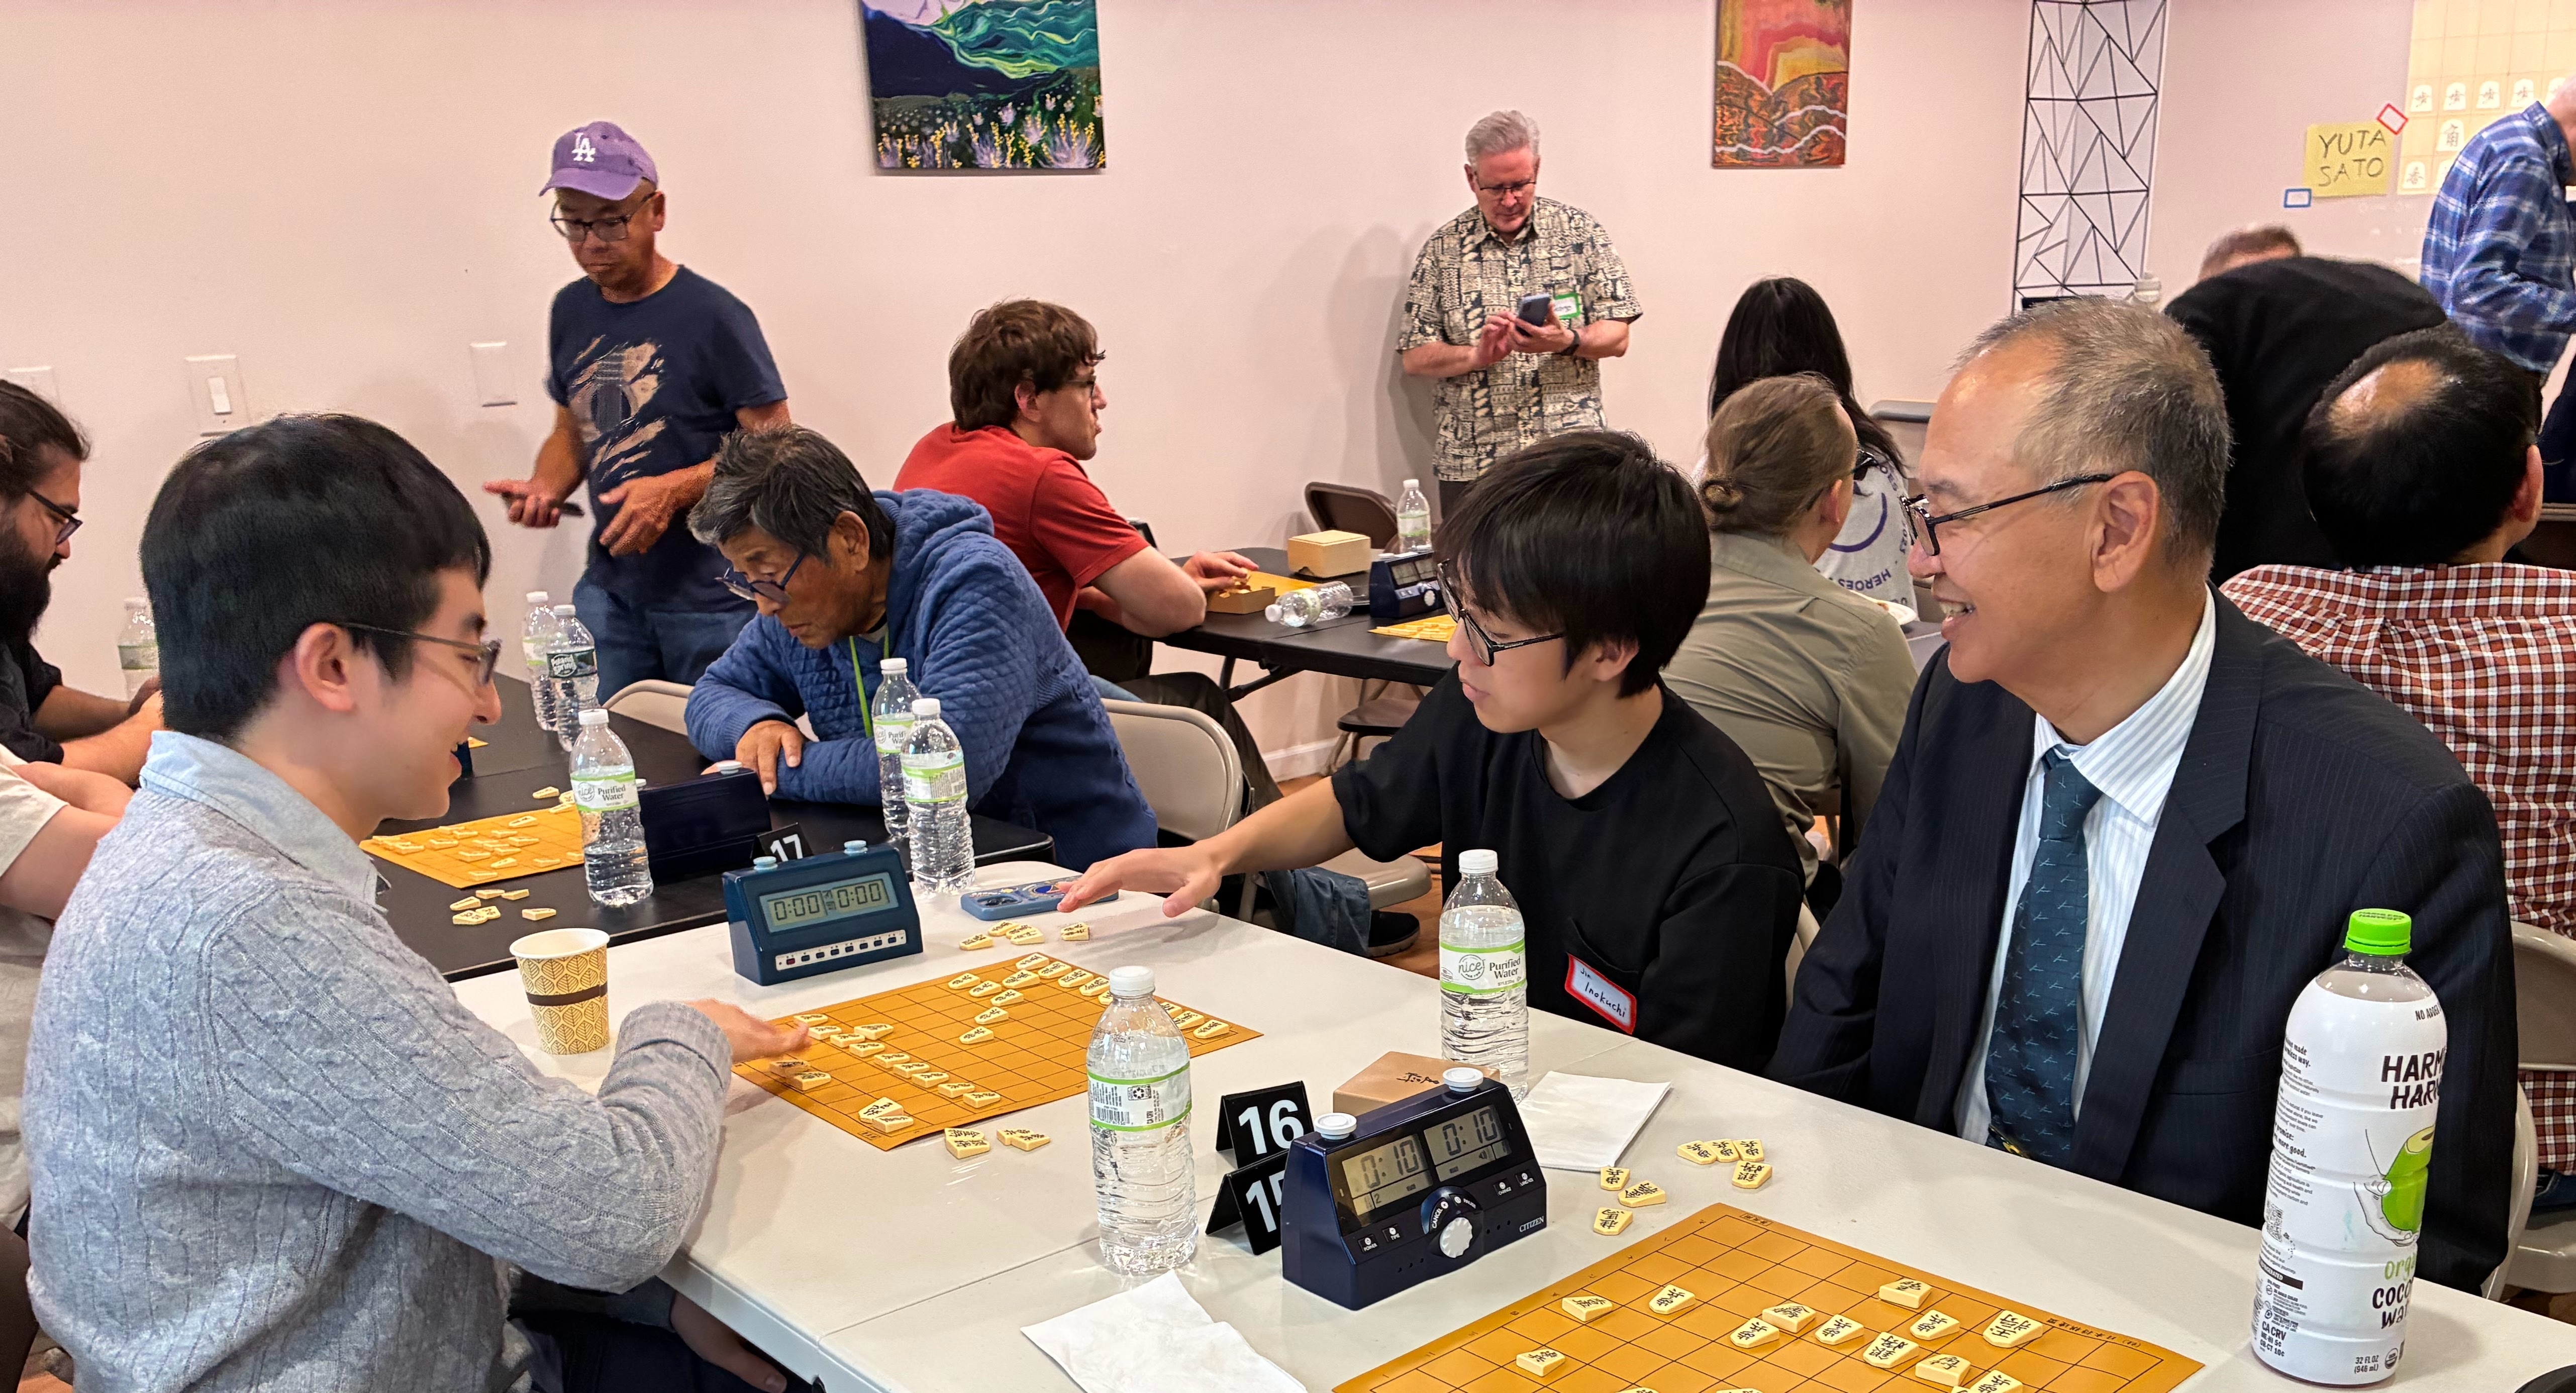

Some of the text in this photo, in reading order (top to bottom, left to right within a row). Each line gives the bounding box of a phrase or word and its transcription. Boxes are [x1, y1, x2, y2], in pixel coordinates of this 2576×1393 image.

[571, 132, 596, 162] LA
[2318, 129, 2387, 159] YUTA
[2318, 157, 2385, 187] SATO
[1837, 568, 1892, 591] HEROES
[598, 784, 626, 795] Purified
[602, 792, 624, 801] Water
[769, 834, 803, 862] 17
[837, 882, 881, 908] 0:00
[774, 894, 820, 921] 0:00
[1489, 955, 1521, 971] Purified
[1494, 967, 1519, 979] Water
[1584, 981, 1627, 1018] Inokuchi
[2415, 1009, 2425, 1021] NO
[1237, 1099, 1305, 1155] 16
[1442, 1109, 1498, 1156] 0:10
[2290, 1146, 2307, 1158] good.
[1360, 1139, 1419, 1189] 0:10
[1373, 1192, 1382, 1204] 2
[1431, 1208, 1443, 1229] CANCEL
[1519, 1216, 1545, 1232] CITIZEN
[1363, 1243, 1378, 1252] POWER
[2262, 1321, 2287, 1341] CA CRV
[2354, 1363, 2379, 1374] (946 mL)
[2355, 1356, 2363, 1365] 32
[2364, 1355, 2371, 1363] FL
[2371, 1354, 2379, 1362] OZ
